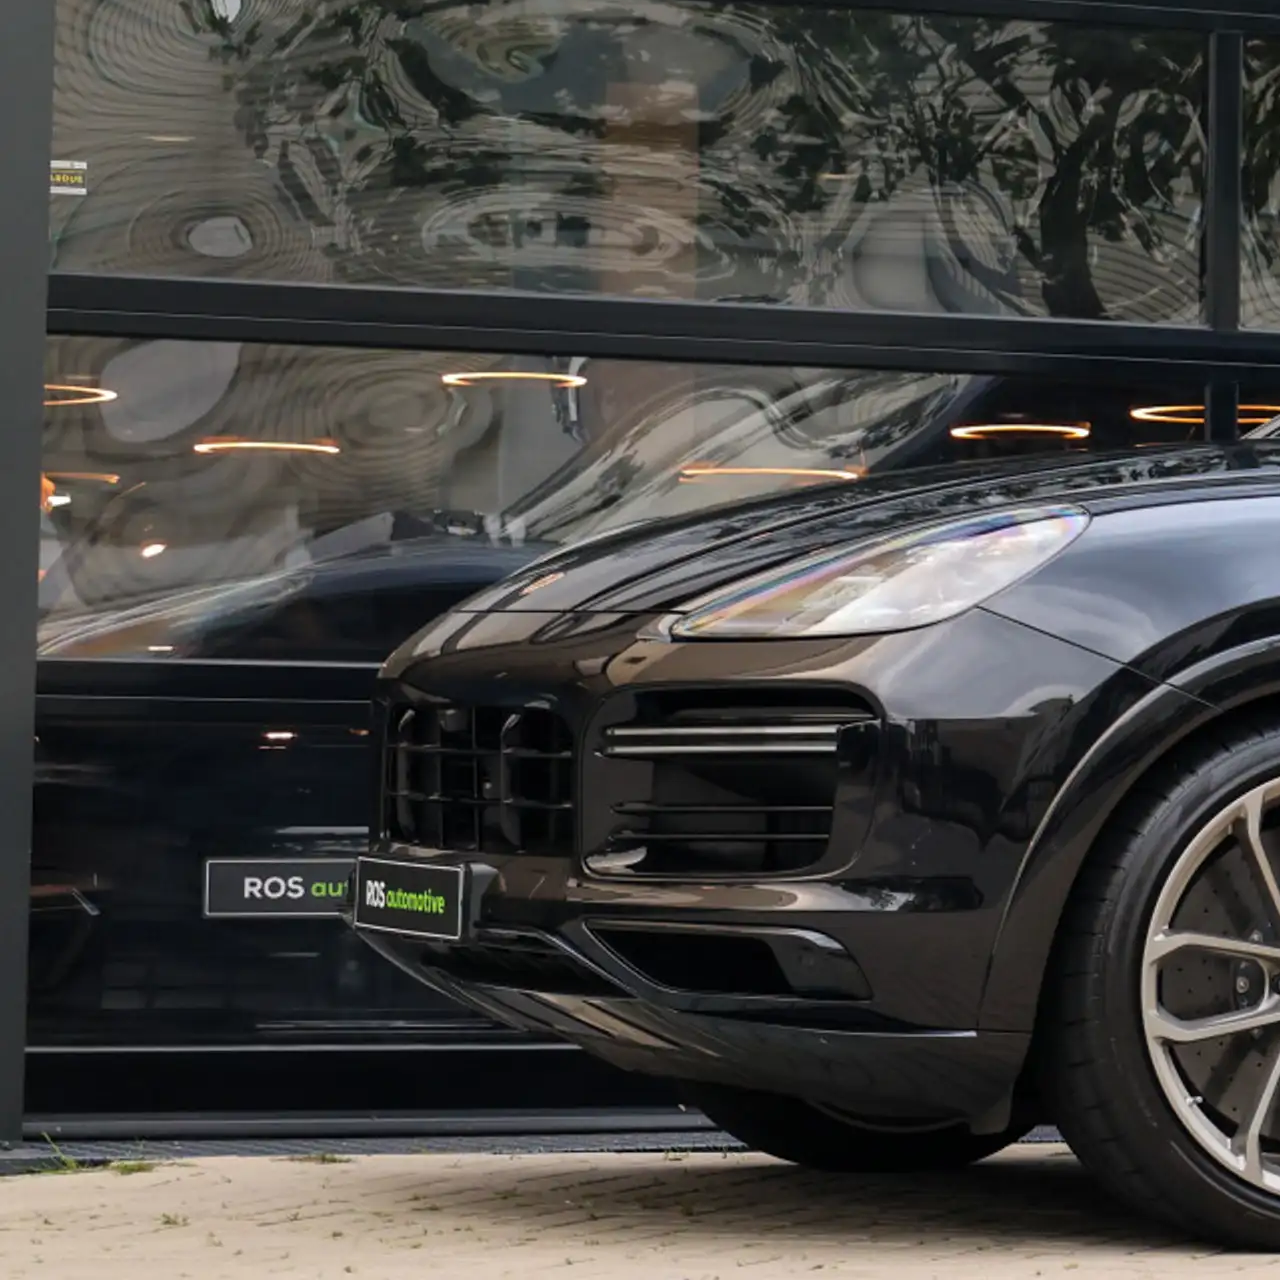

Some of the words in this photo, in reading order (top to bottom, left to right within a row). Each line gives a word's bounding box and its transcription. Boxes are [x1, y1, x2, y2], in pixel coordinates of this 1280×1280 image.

[244, 876, 305, 899] ROS
[366, 880, 386, 909] ROS
[387, 888, 445, 914] automotive
